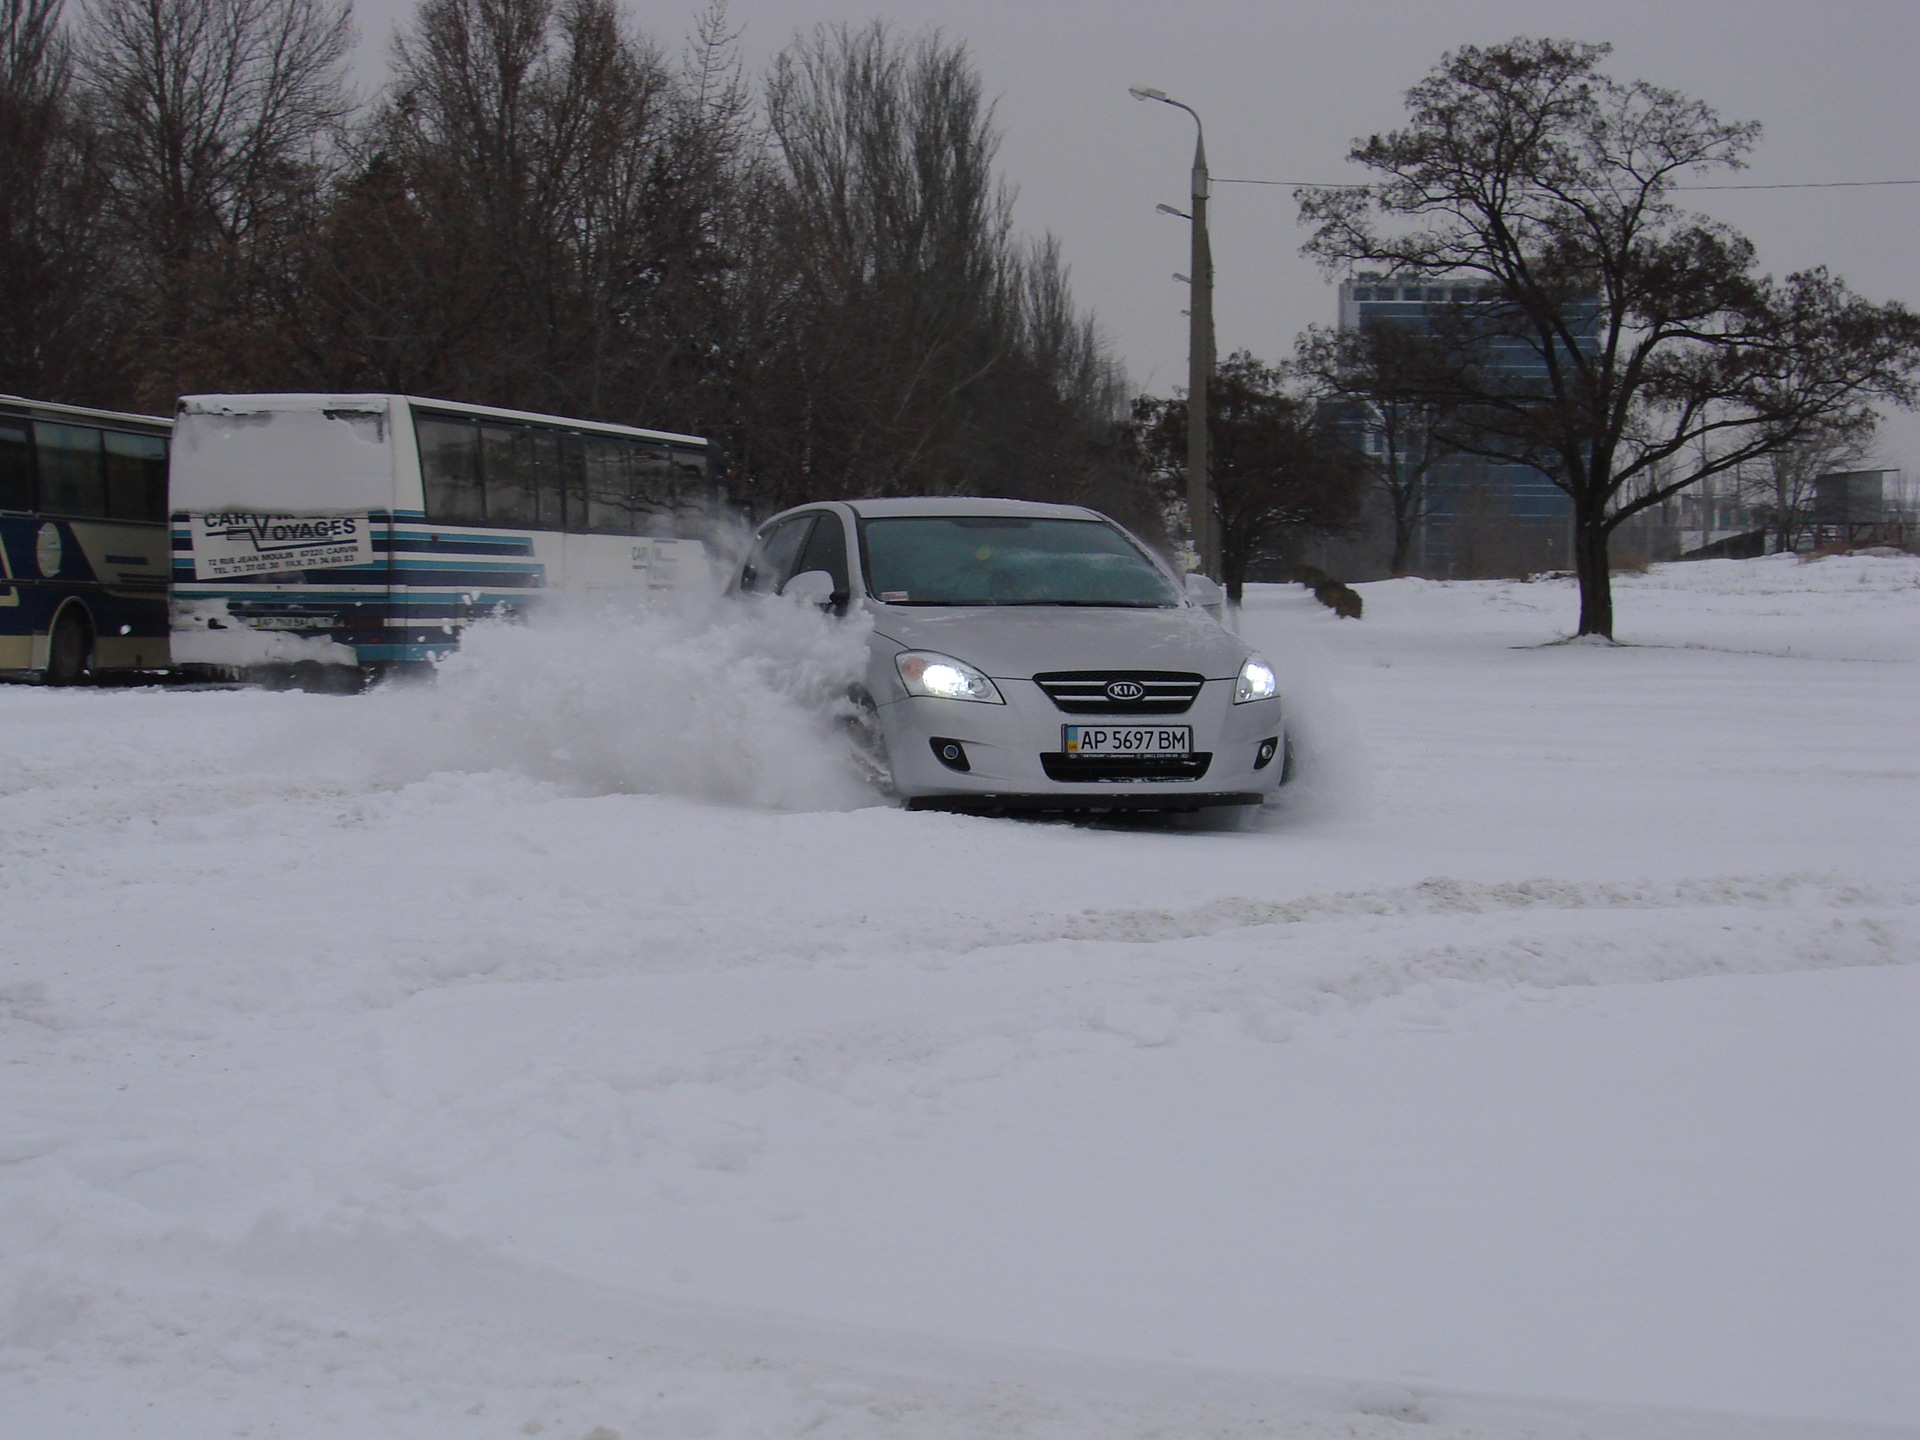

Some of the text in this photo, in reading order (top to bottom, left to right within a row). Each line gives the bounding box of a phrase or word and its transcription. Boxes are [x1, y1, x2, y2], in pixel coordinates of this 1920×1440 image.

[251, 514, 357, 541] VOYAGES
[219, 557, 235, 565] RUE
[237, 555, 259, 564] JEAN
[261, 552, 294, 561] MOULIN
[326, 545, 359, 555] CARVIN
[1113, 685, 1138, 696] KIA
[1081, 731, 1185, 750] AP 5697 BM
